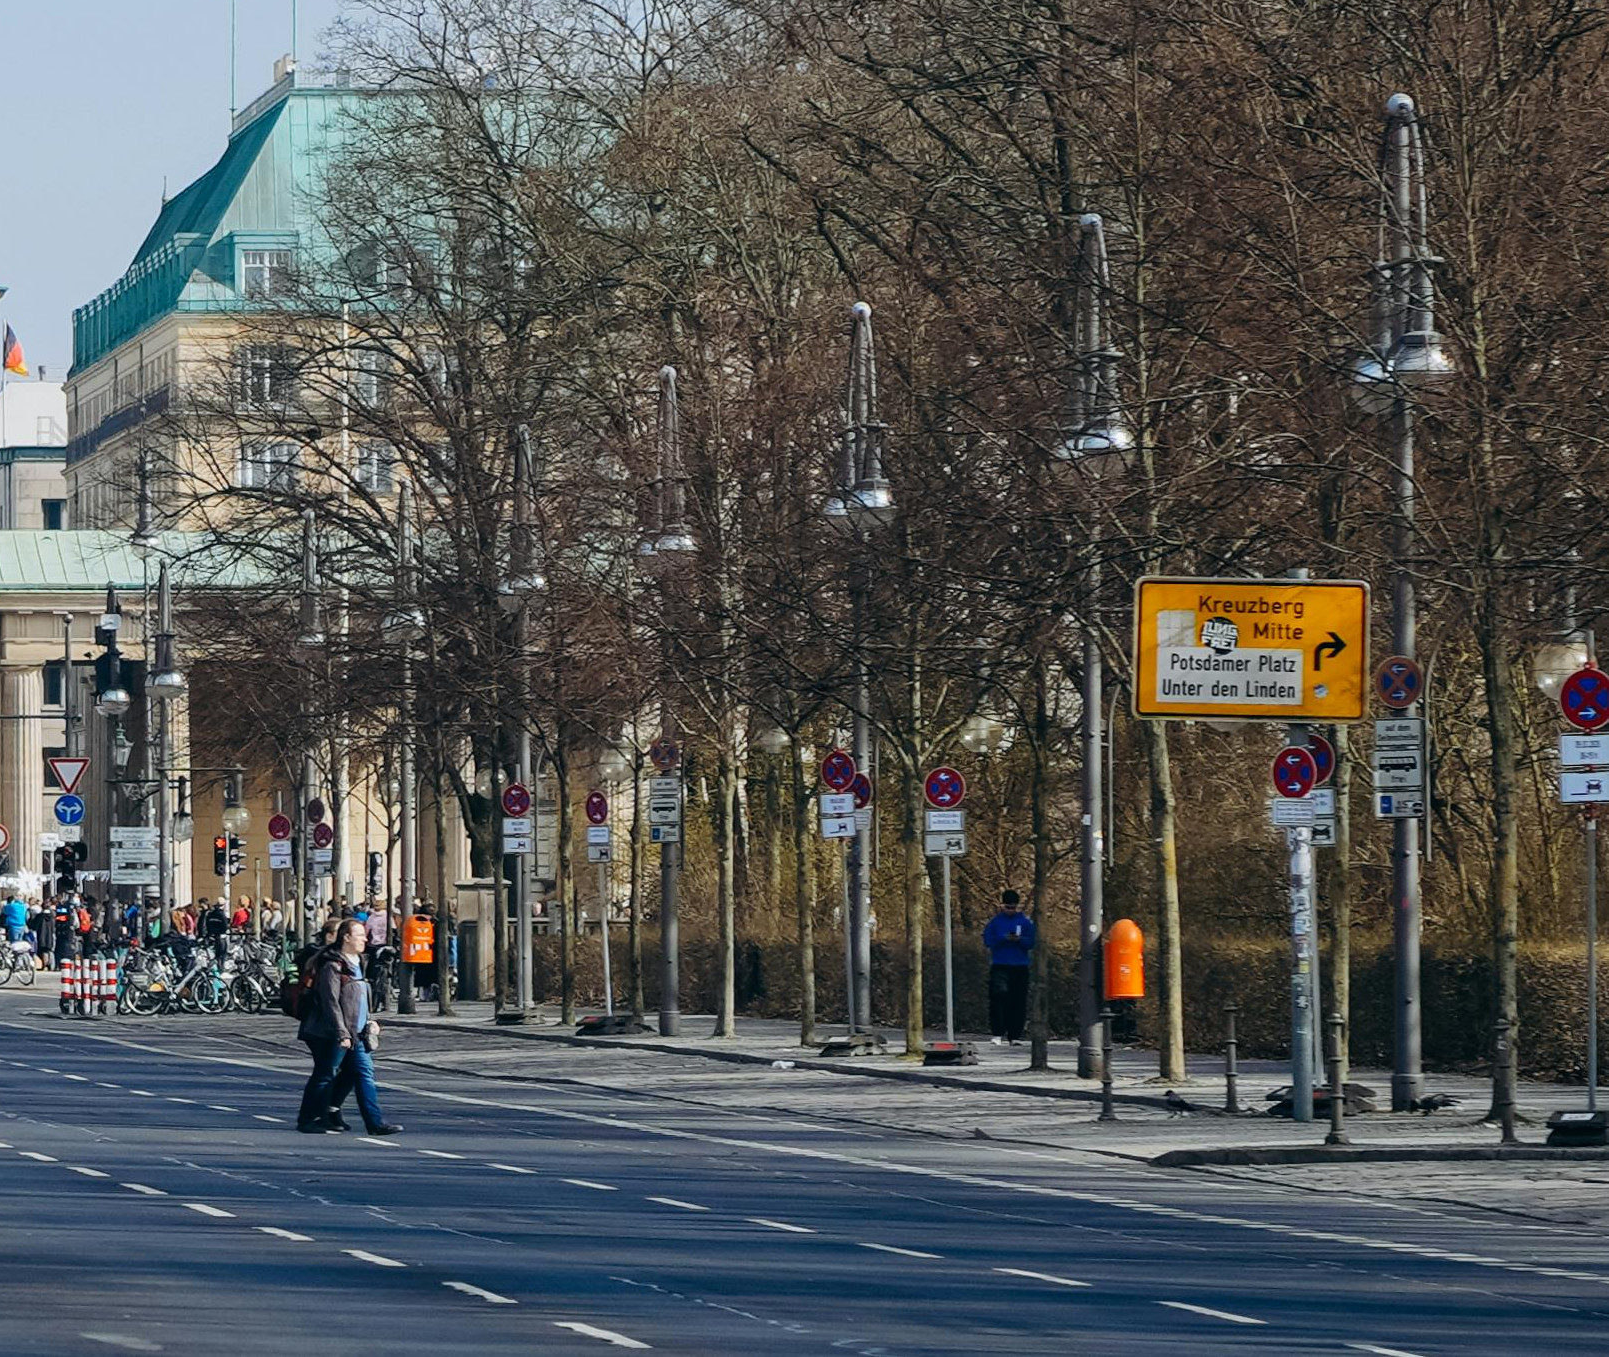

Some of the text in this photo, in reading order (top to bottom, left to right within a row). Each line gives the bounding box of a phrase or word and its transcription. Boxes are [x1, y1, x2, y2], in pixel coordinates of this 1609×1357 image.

[1198, 595, 1304, 618] Kreuzberg
[1253, 622, 1304, 640] Mitte
[1170, 653, 1296, 673] Potsdamer Platz
[1162, 679, 1295, 698] Unter den Linden
